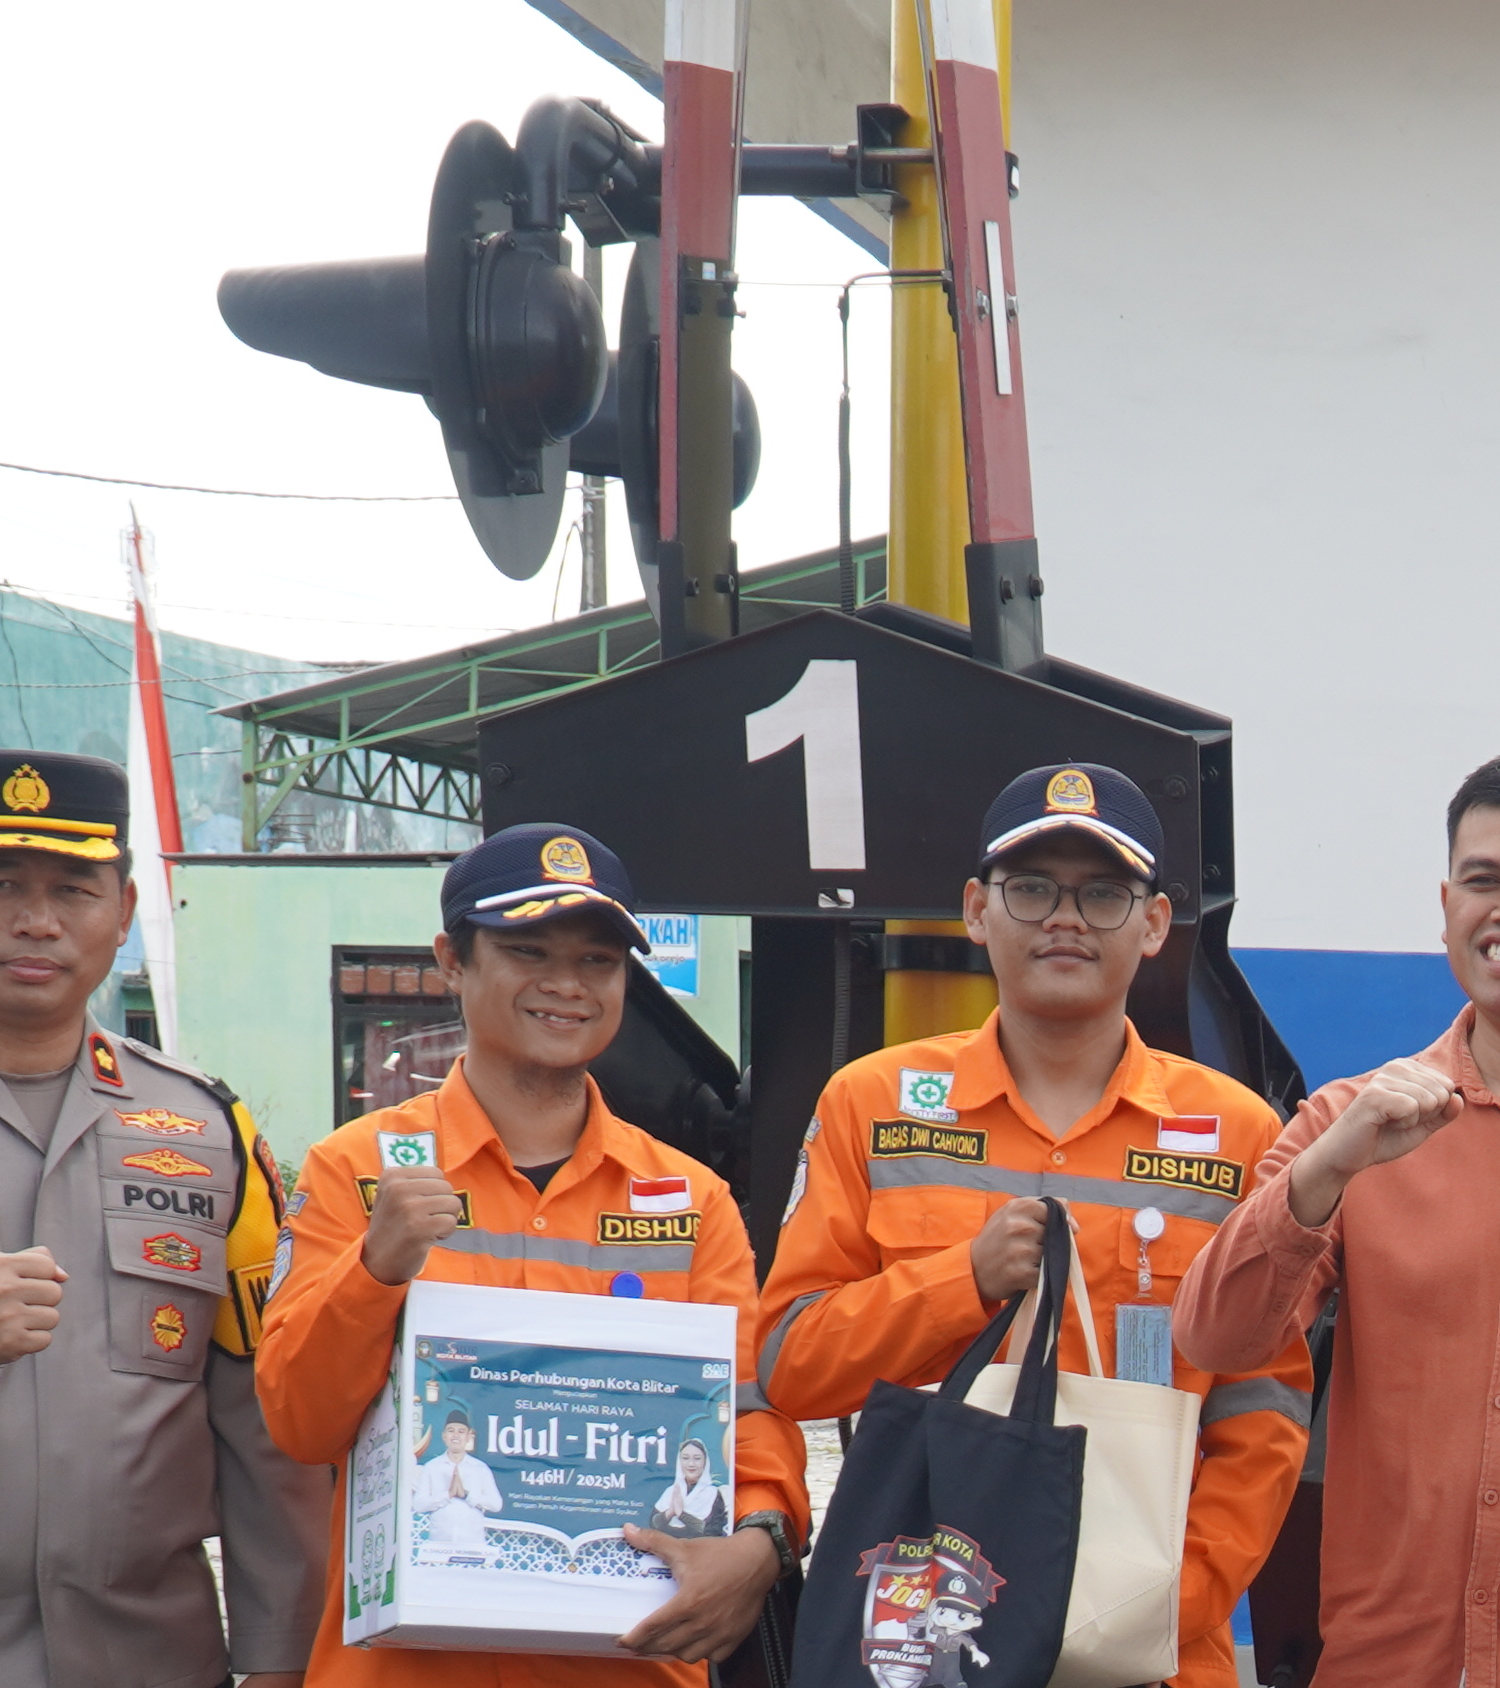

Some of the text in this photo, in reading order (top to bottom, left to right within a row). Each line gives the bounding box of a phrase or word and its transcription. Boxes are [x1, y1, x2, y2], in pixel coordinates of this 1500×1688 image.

[745, 659, 867, 870] 1
[910, 1127, 930, 1148] DWI
[933, 1131, 978, 1156] CAHYONO
[1132, 1154, 1235, 1189] DISHUB
[123, 1184, 215, 1220] POLRI
[470, 1366, 680, 1394] Dinas Perhubungan Kota Blitar
[514, 1399, 635, 1418] SELAMAT HARI RAYA
[486, 1415, 668, 1466] Idul - Fitri
[520, 1468, 565, 1486] 1446H
[576, 1472, 626, 1490] 2025M
[943, 1534, 975, 1562] KOTA
[876, 1583, 932, 1609] JOGO
